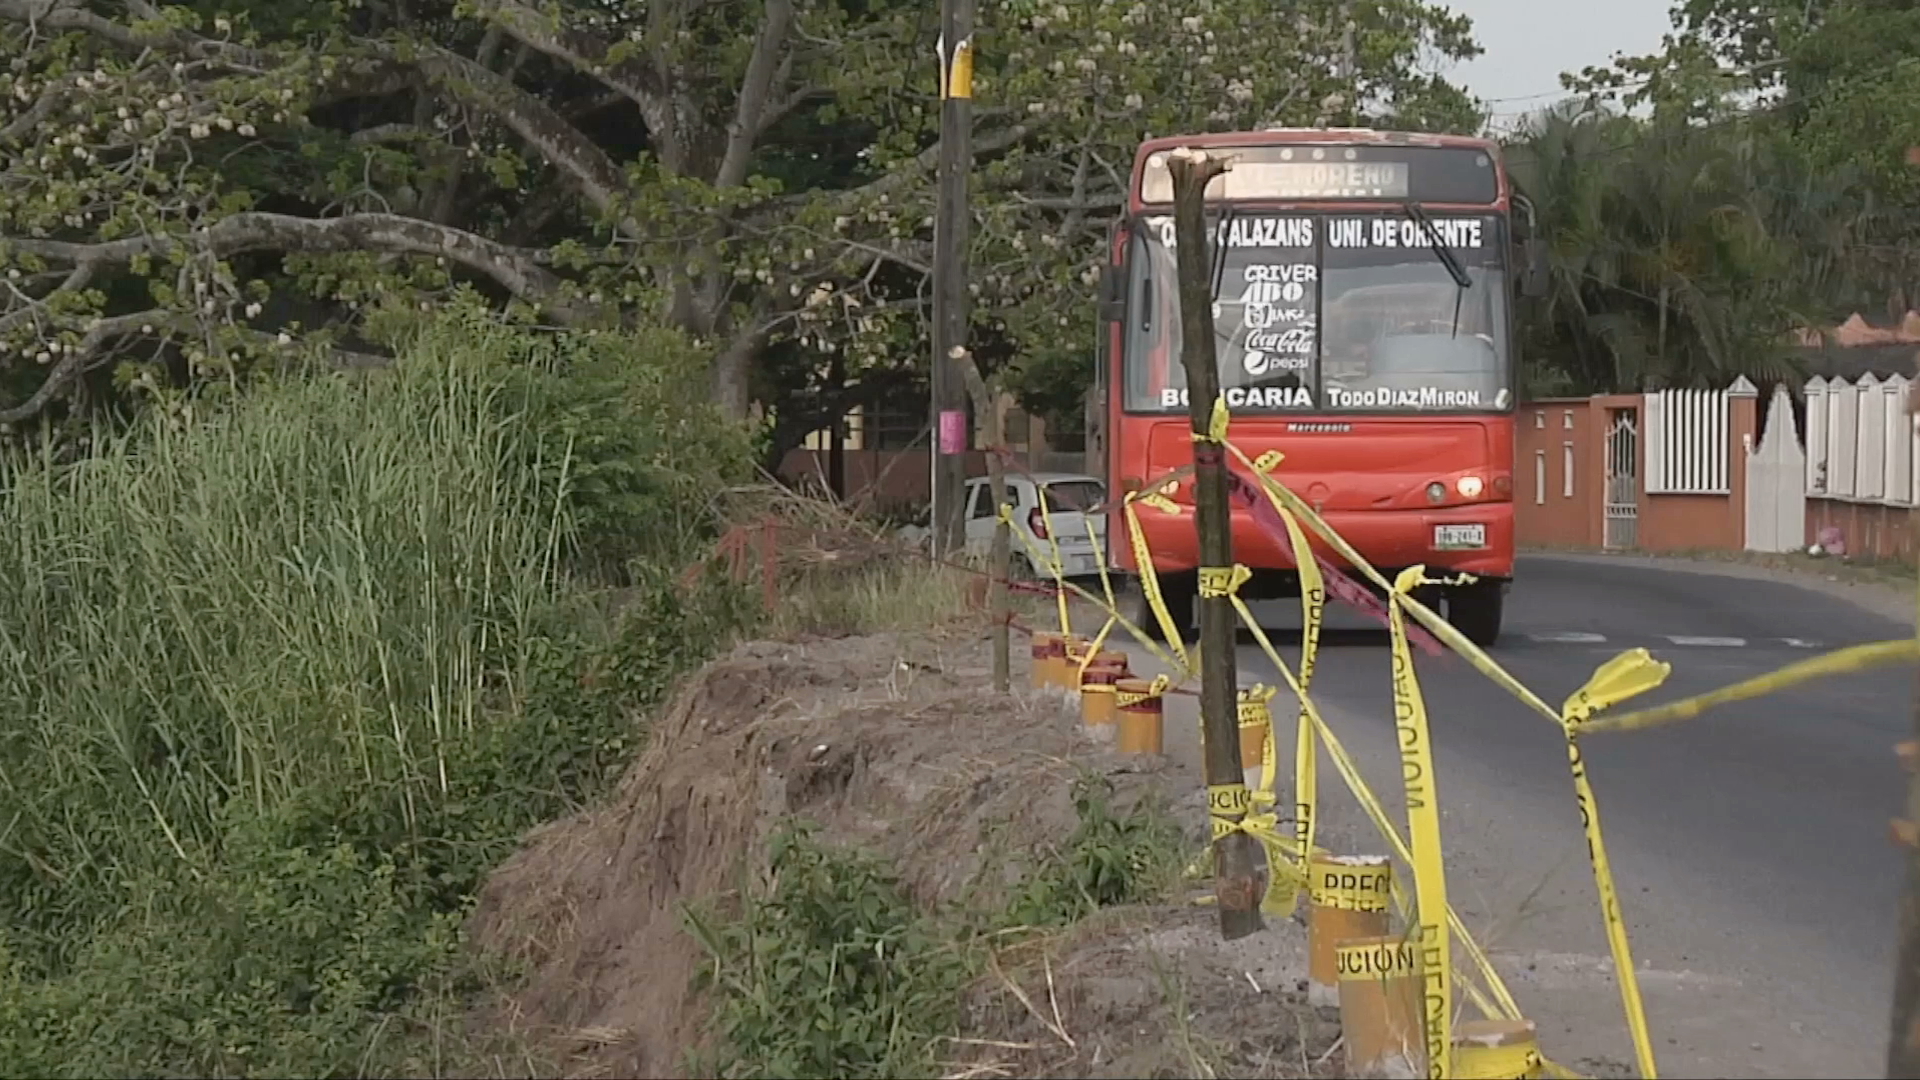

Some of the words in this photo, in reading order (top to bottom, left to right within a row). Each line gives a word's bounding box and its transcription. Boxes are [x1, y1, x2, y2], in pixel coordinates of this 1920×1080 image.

[1329, 219, 1368, 248] UNI.
[1372, 219, 1397, 248] DE
[1244, 264, 1317, 282] CRIVER
[1270, 357, 1309, 370] pepsi
